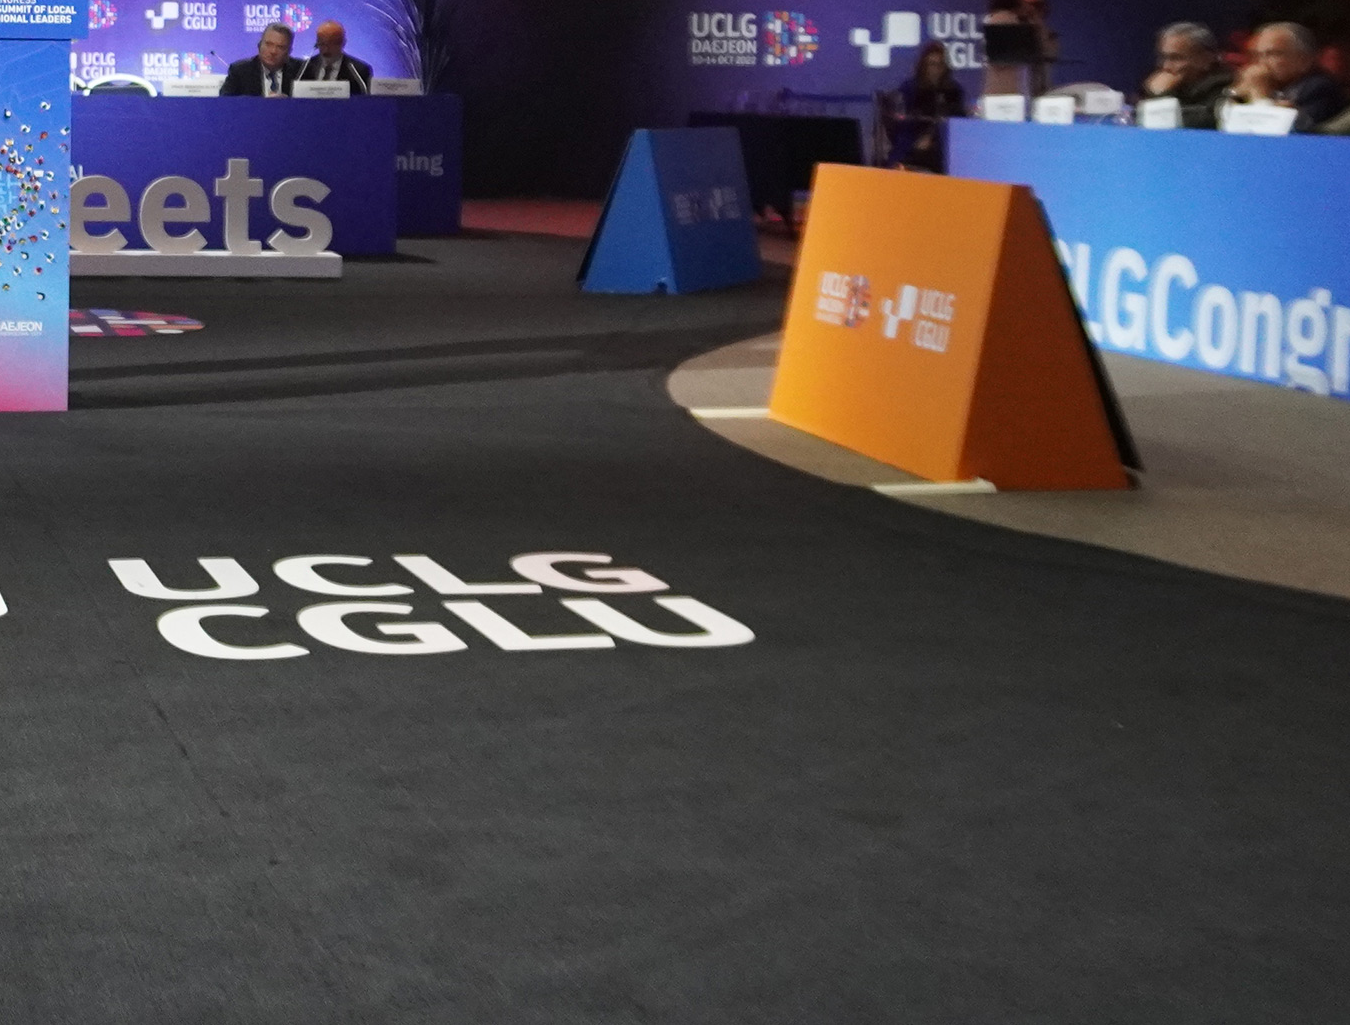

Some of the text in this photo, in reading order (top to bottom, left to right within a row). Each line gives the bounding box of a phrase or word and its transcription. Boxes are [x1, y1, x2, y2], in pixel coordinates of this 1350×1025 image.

[33, 5, 46, 14] OF
[48, 6, 77, 15] LOCAL
[183, 2, 217, 16] UCLG
[244, 4, 281, 18] UCLG
[30, 14, 72, 24] LEADERS
[183, 17, 217, 31] CGLU
[691, 12, 758, 38] UCLG
[930, 11, 985, 40] UCL
[691, 38, 758, 54] DAEJEON
[81, 52, 116, 66] UCLG
[142, 53, 180, 68] UCLG
[108, 552, 671, 601] UCLG
[157, 595, 756, 661] CGLU
